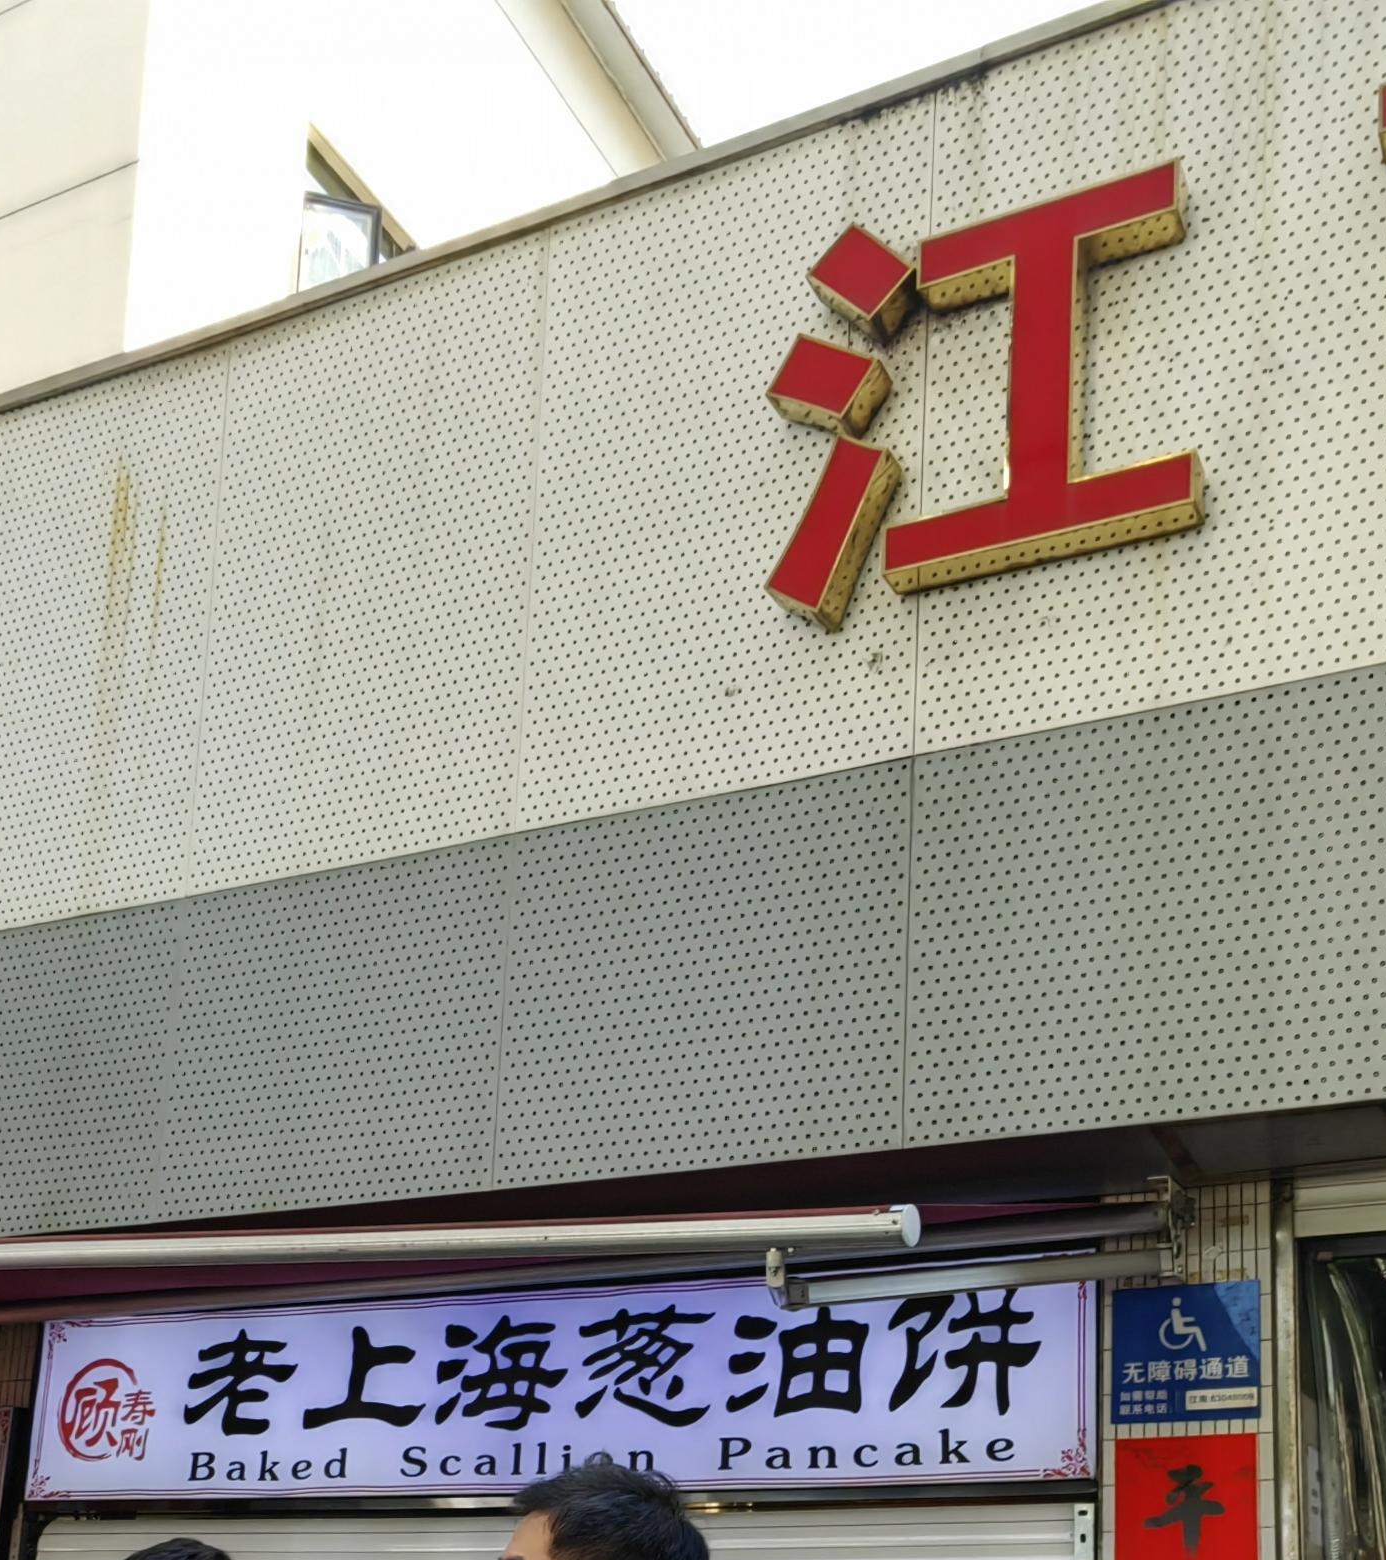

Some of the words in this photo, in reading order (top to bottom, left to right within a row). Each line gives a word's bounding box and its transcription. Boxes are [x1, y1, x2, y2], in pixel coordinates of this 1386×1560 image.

[183, 1287, 1042, 1436] 老上海葱油饼
[1122, 1355, 1250, 1384] 无障碍通道
[188, 1448, 348, 1482] Baked
[717, 1429, 1016, 1470] Pancake
